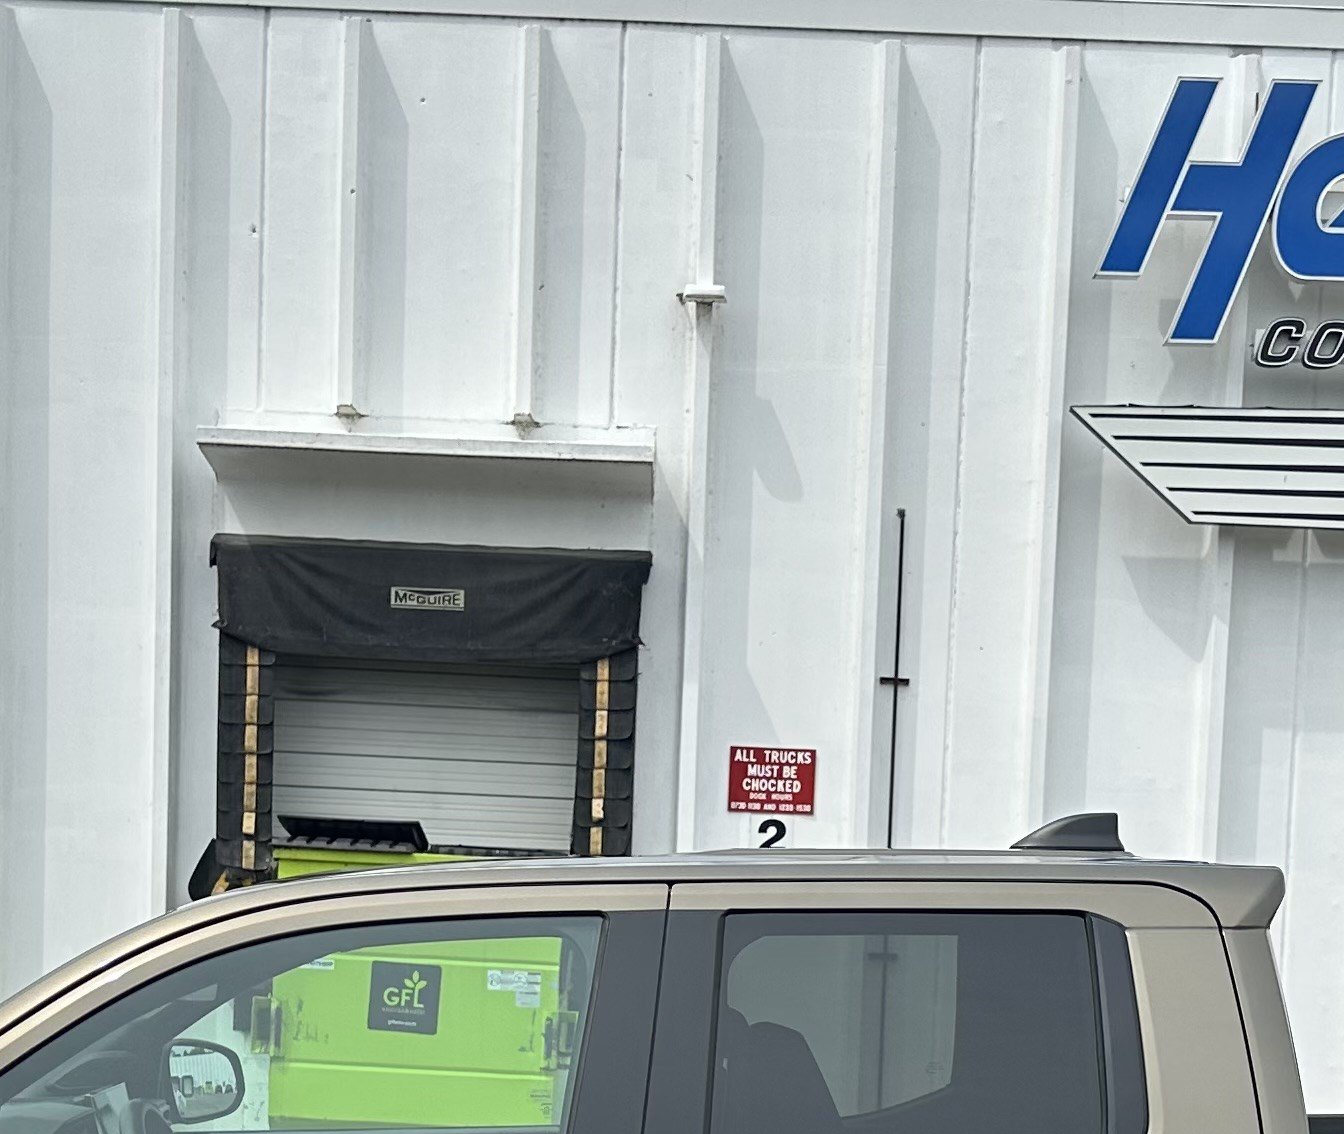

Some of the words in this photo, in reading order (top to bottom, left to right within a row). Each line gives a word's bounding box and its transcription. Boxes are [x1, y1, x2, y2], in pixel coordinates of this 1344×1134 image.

[734, 749, 756, 762] ALL
[764, 750, 812, 764] TRUCKS
[747, 764, 779, 778] MUST
[782, 766, 798, 778] BE
[742, 778, 801, 793] CHOCKED
[758, 819, 787, 849] 2
[383, 985, 425, 1008] GFL
